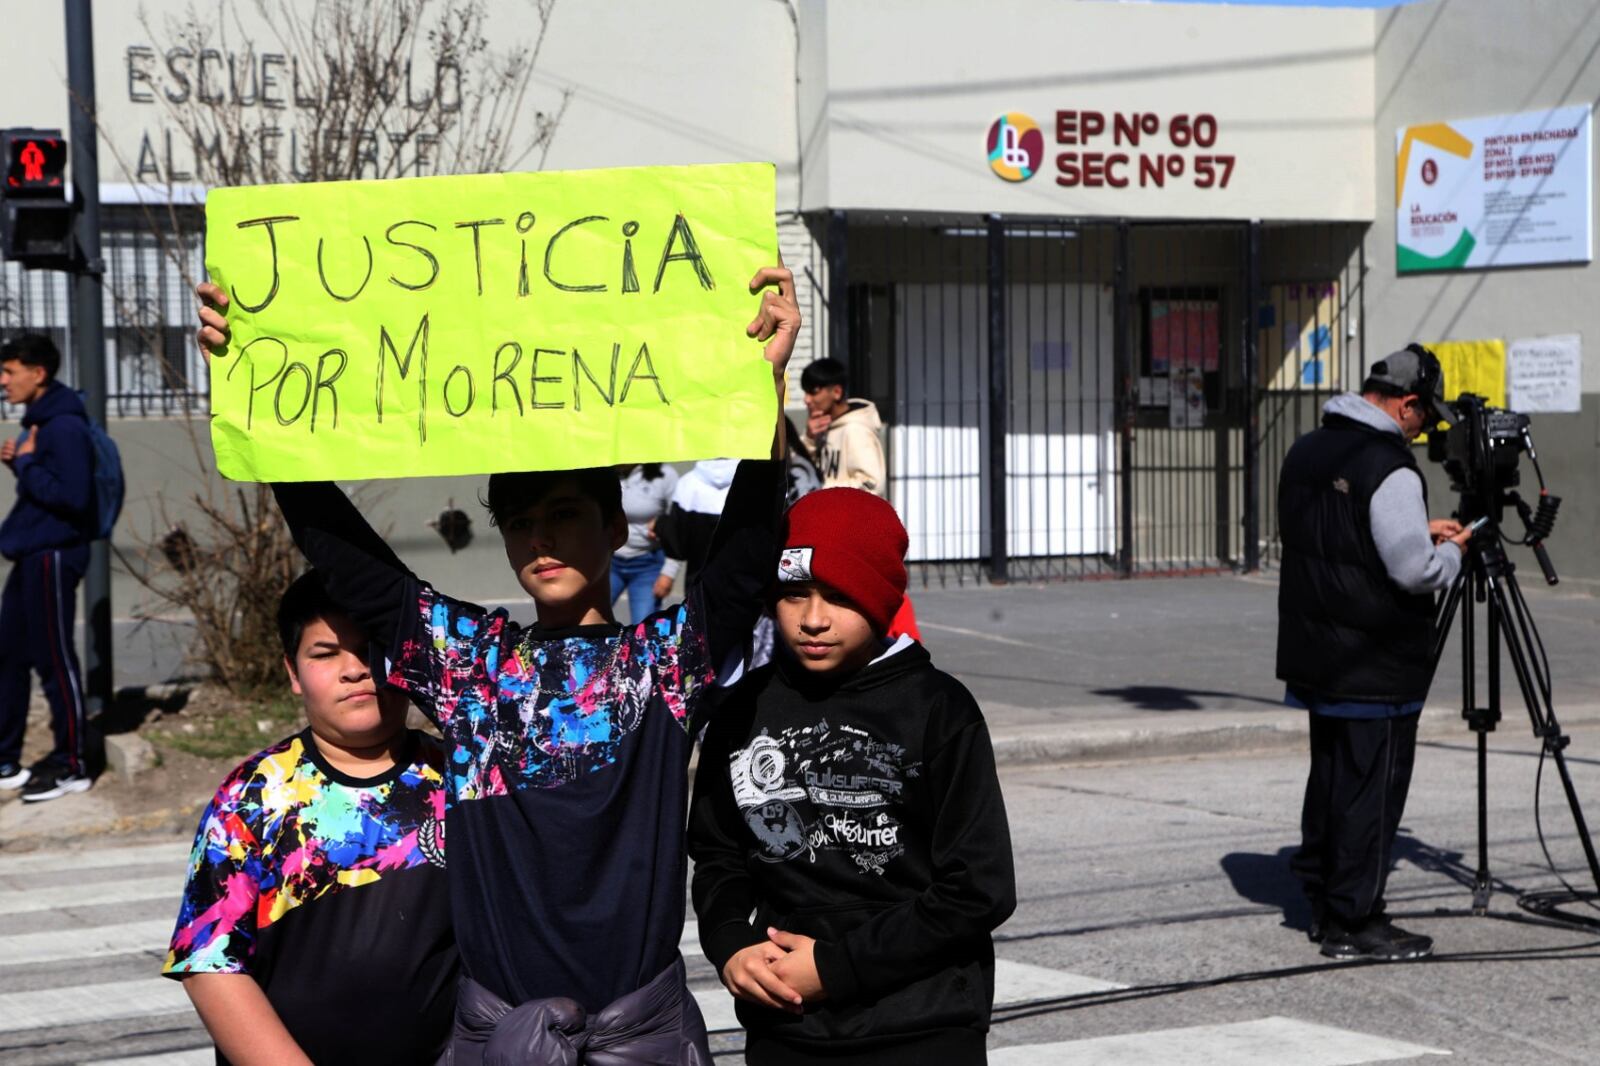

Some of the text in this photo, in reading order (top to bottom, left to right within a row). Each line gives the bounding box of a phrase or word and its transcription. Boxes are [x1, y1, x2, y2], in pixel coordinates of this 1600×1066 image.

[1056, 110, 1105, 145] EP
[1168, 114, 1218, 148] 60
[1055, 153, 1130, 188] SEC
[1194, 156, 1236, 188] 57
[228, 336, 348, 434] POR
